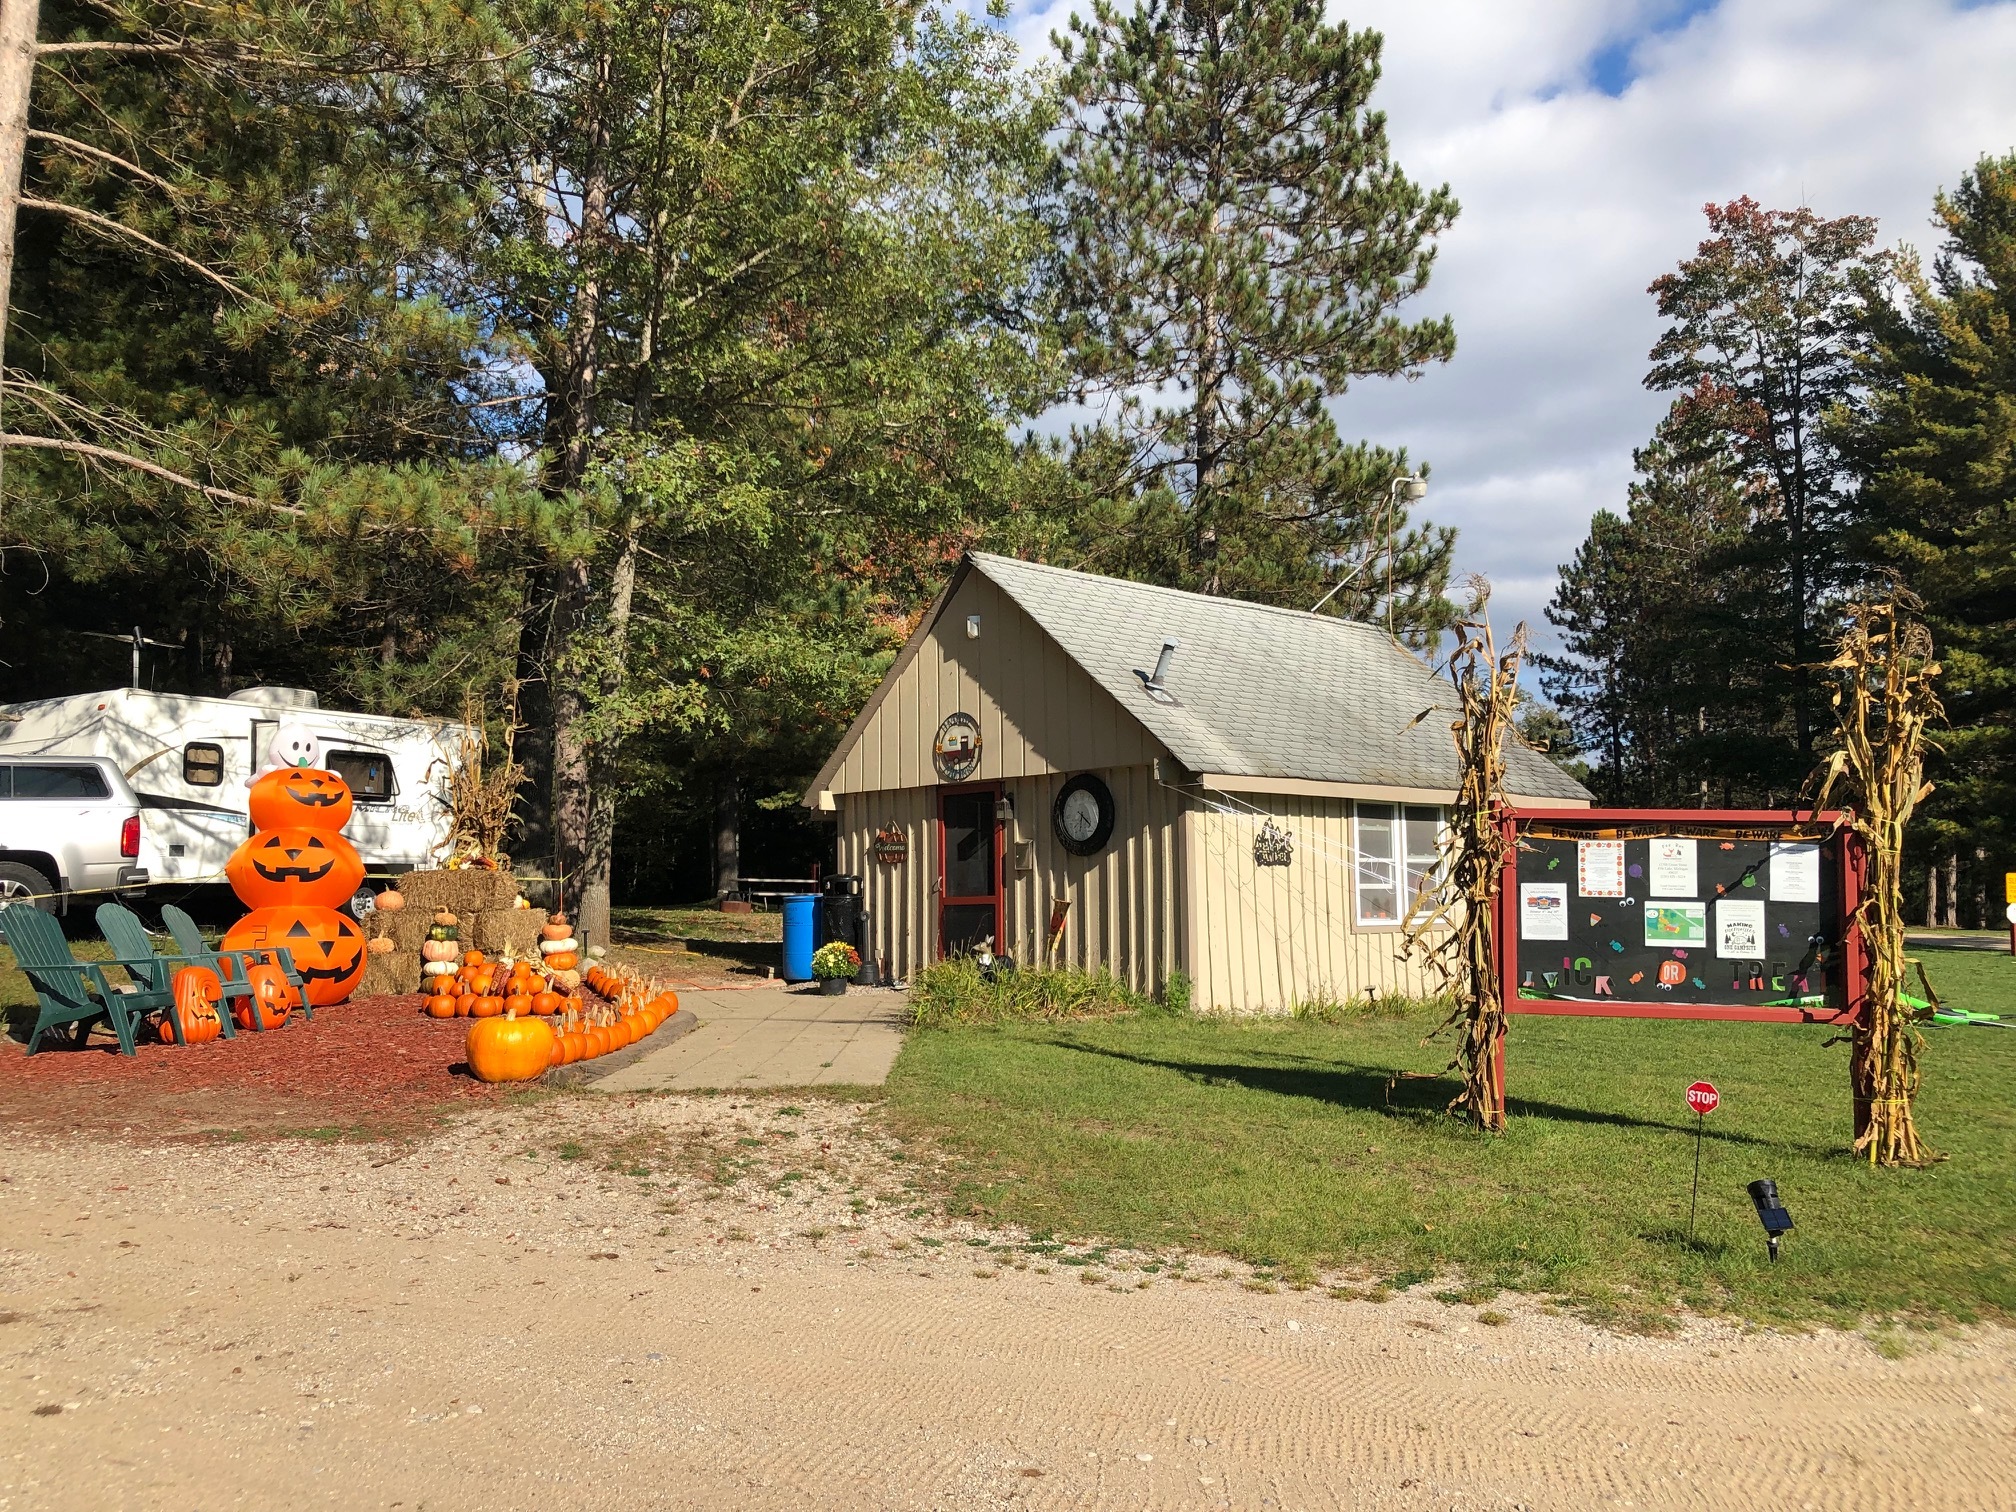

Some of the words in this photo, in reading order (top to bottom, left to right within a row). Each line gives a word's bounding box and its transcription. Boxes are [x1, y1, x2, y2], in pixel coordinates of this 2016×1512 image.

[1551, 828, 1600, 841] BEWARE
[1616, 825, 1664, 839] BEWARE
[1669, 824, 1718, 837] BEWARE
[1735, 830, 1784, 840] BEWARE
[875, 843, 905, 852] Welcome
[1663, 965, 1679, 981] OR
[1688, 1089, 1717, 1105] STOP
